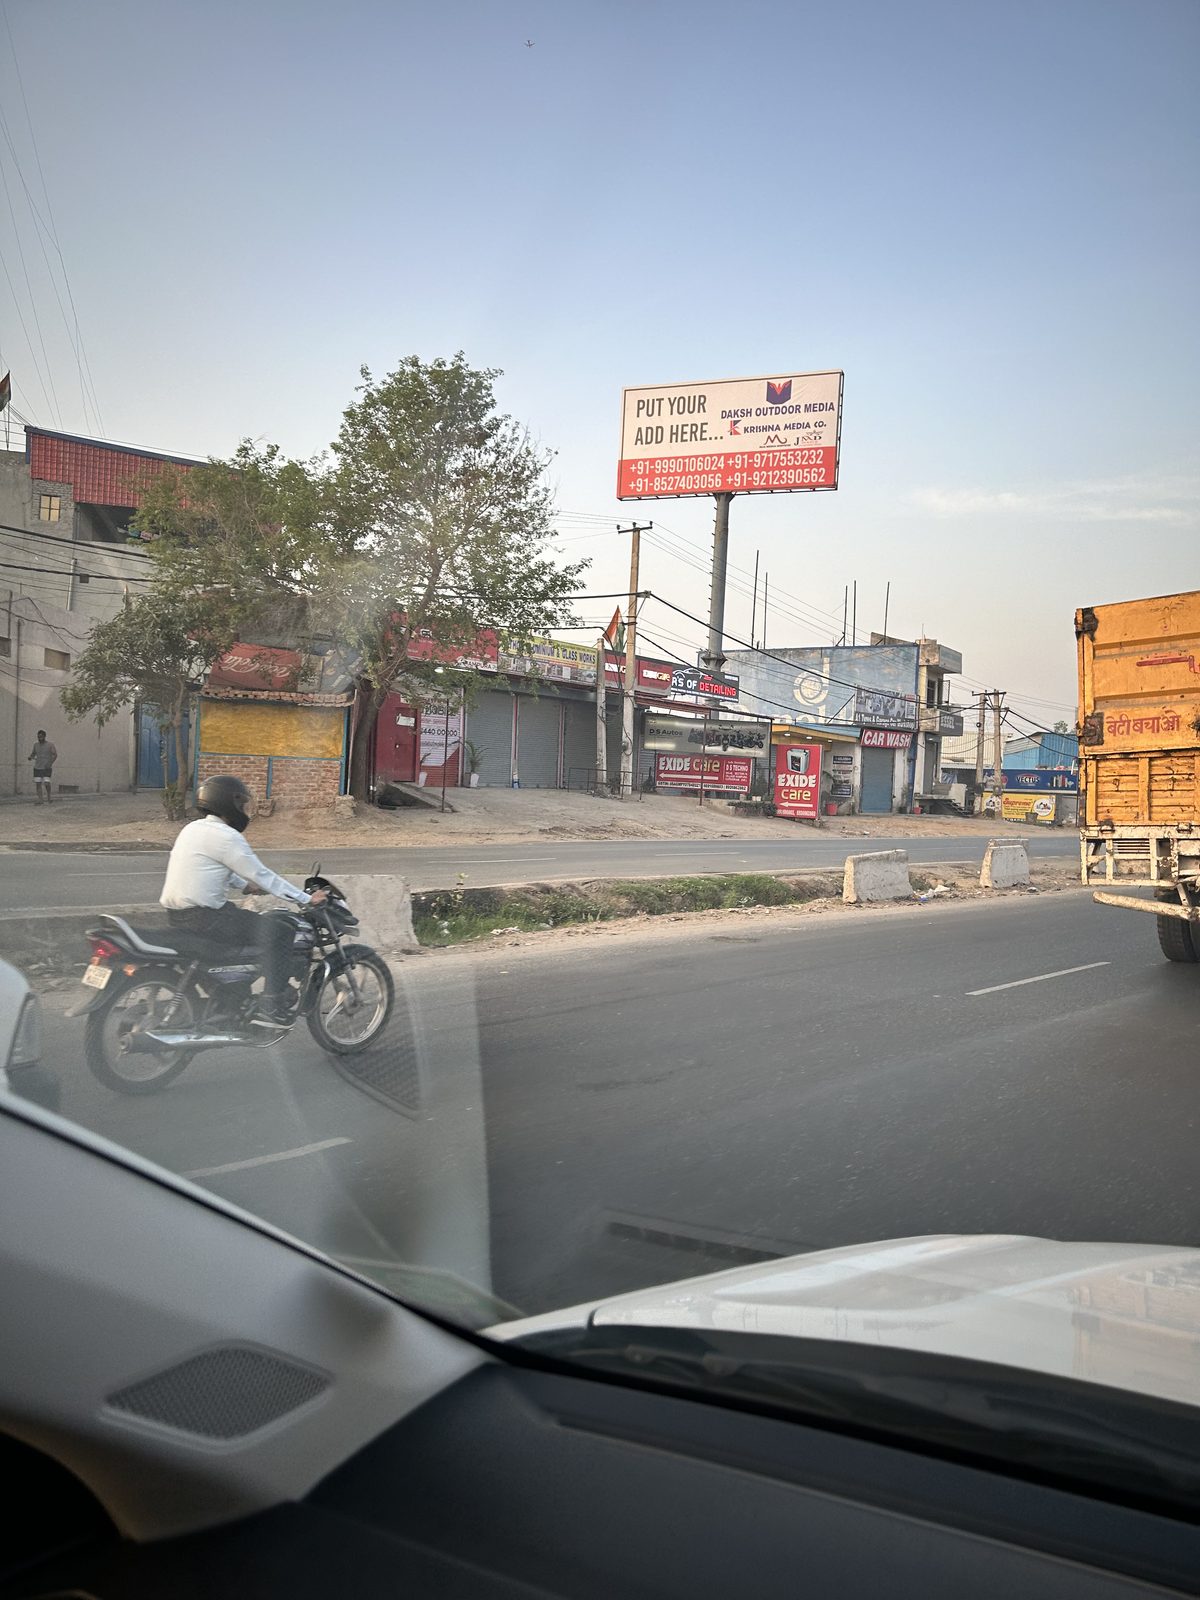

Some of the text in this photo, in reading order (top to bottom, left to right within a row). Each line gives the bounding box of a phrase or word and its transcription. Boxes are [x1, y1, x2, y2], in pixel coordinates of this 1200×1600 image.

[637, 395, 707, 418] PUT YOUR
[720, 402, 835, 419] DAKSH OUTDOOR MEDIA
[634, 422, 724, 446] ADD HERE...
[743, 423, 781, 434] KRISHNA
[783, 422, 811, 431] MEDIA
[630, 449, 824, 475] +91-9990106024 +91-9717553232
[629, 467, 826, 492] +91-8527403056 +91-9212390562
[562, 647, 578, 661] GLASS
[579, 651, 596, 665] WORKS
[686, 679, 698, 689] OF
[699, 681, 737, 696] DETAILING
[1105, 710, 1181, 736] बेटी बचाओ
[863, 731, 911, 748] CAR WASH
[659, 756, 720, 772] EXIDE care
[777, 774, 817, 788] EXIDE
[781, 788, 811, 801] care
